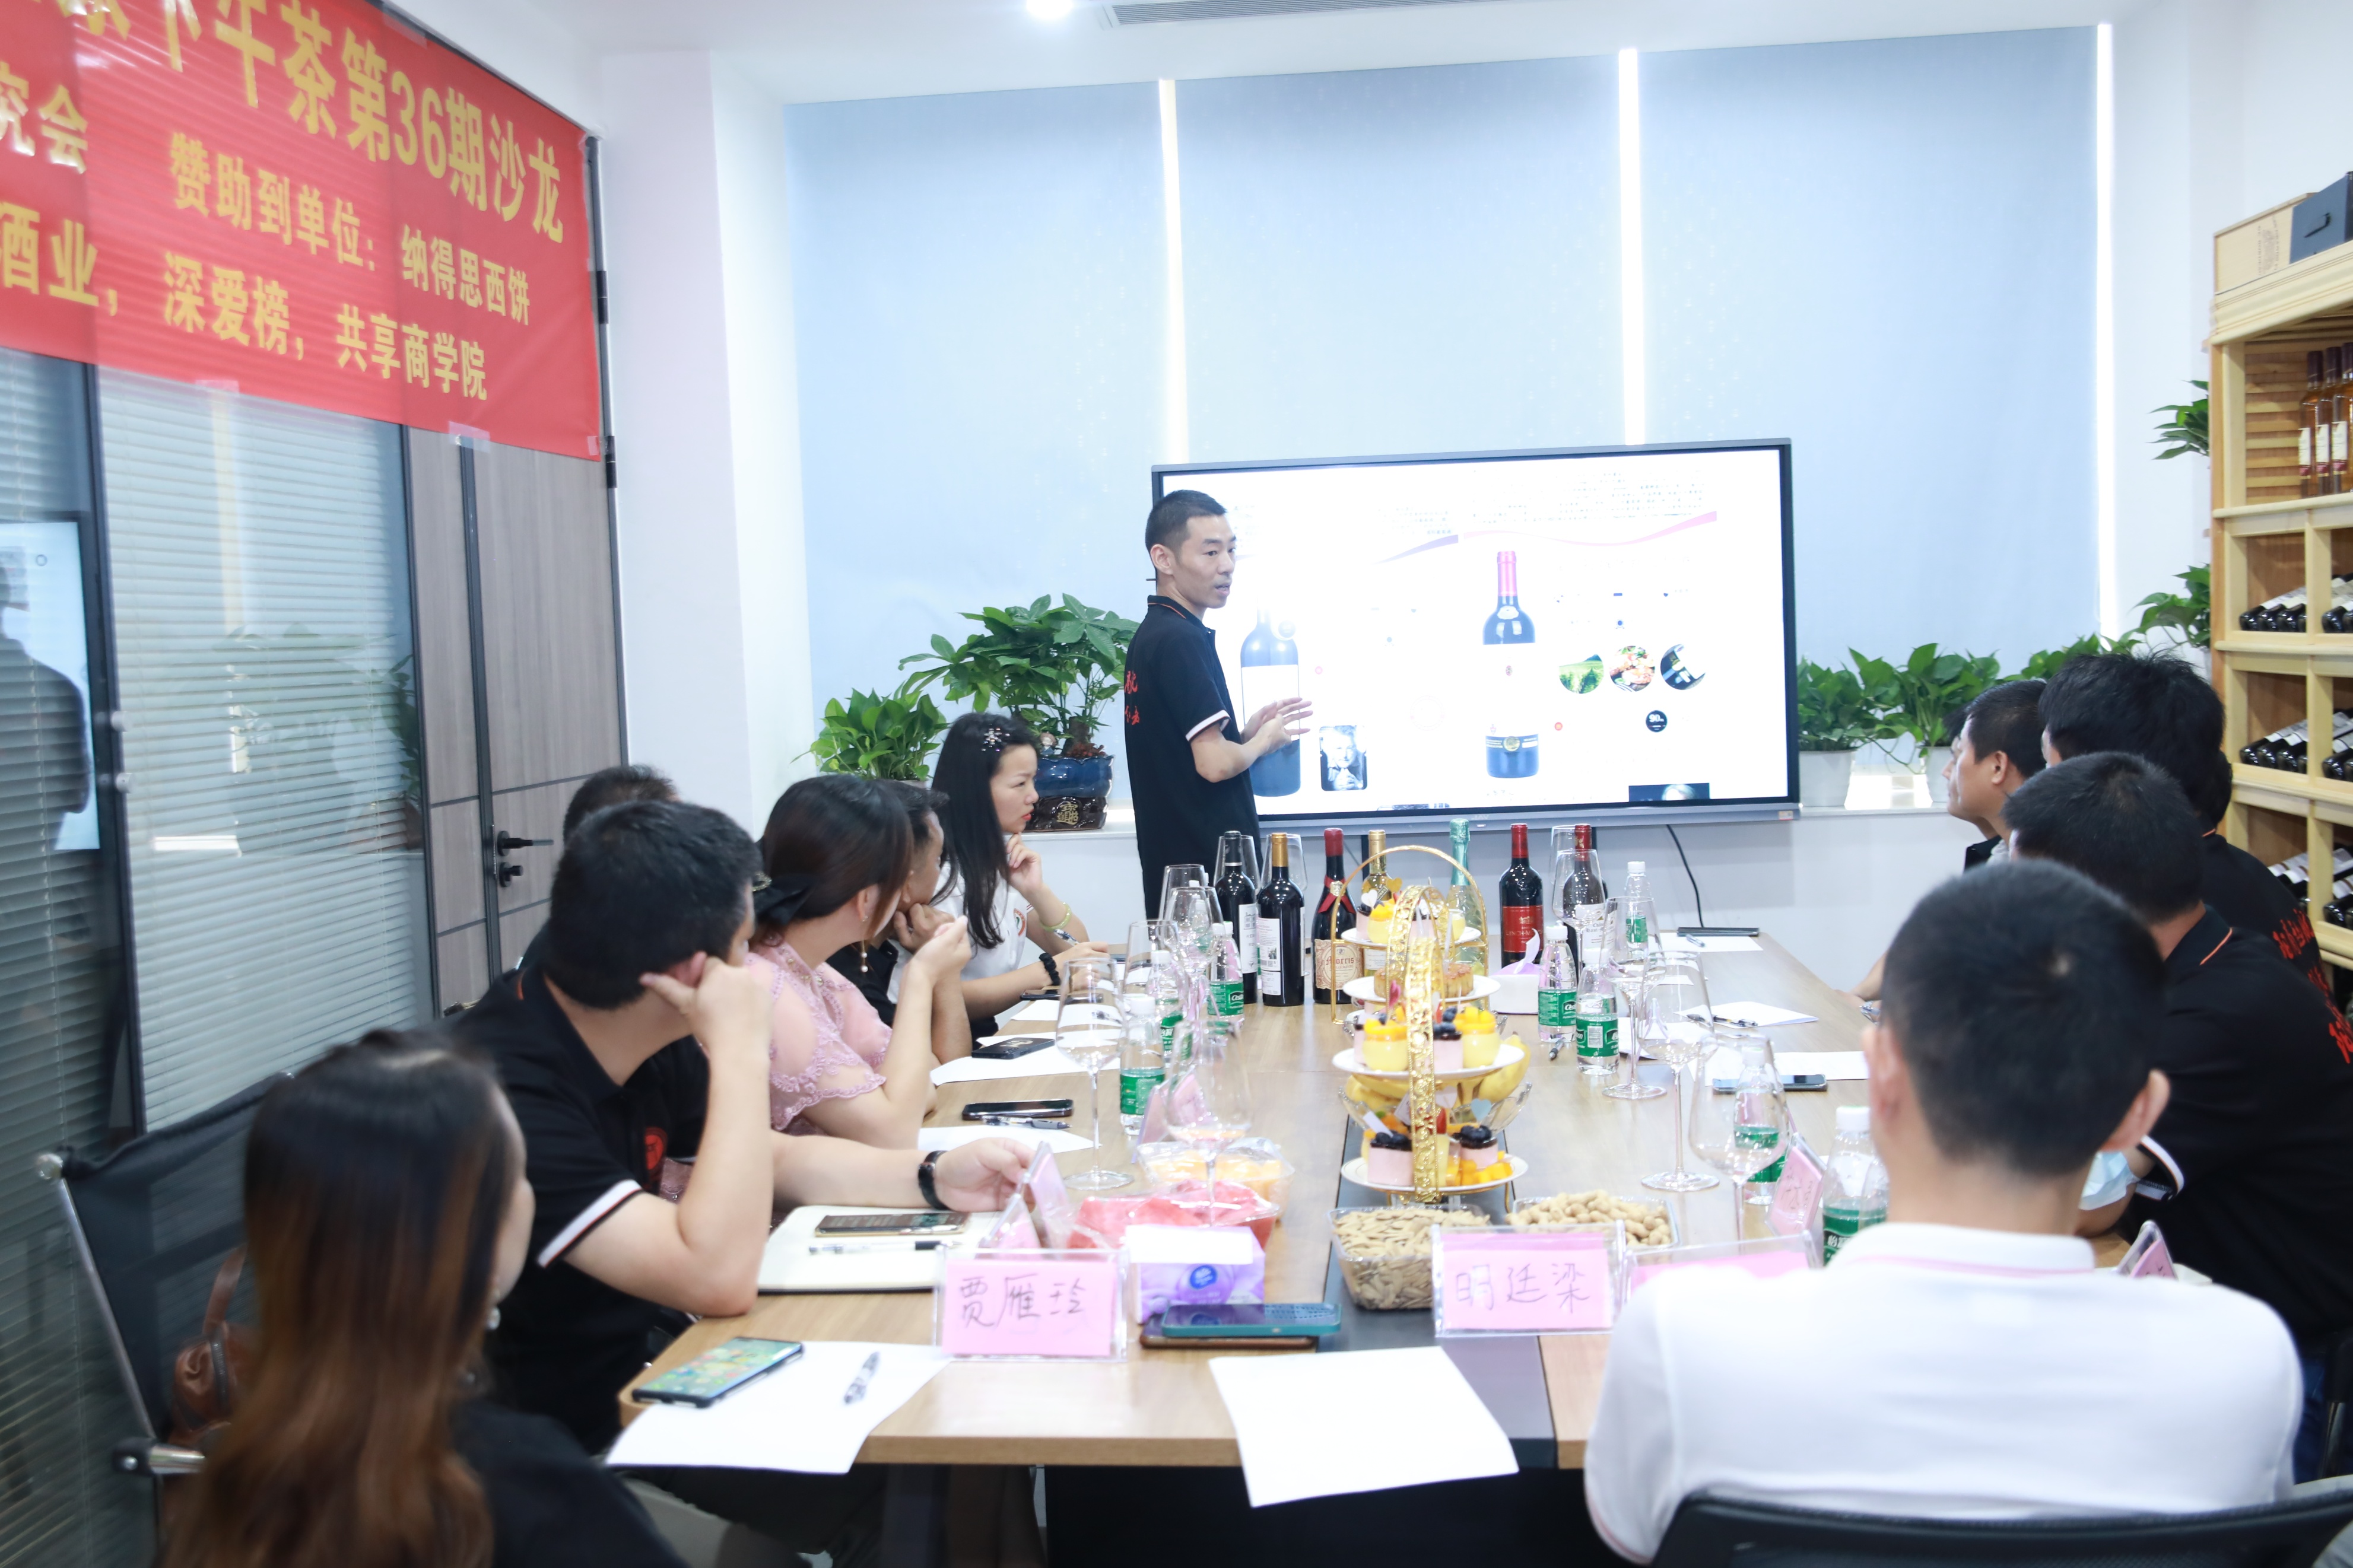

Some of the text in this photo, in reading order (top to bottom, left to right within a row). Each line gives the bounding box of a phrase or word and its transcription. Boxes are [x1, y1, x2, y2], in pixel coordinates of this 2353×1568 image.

[402, 224, 531, 326] 纳得思西饼
[336, 304, 487, 402] 共享商学院
